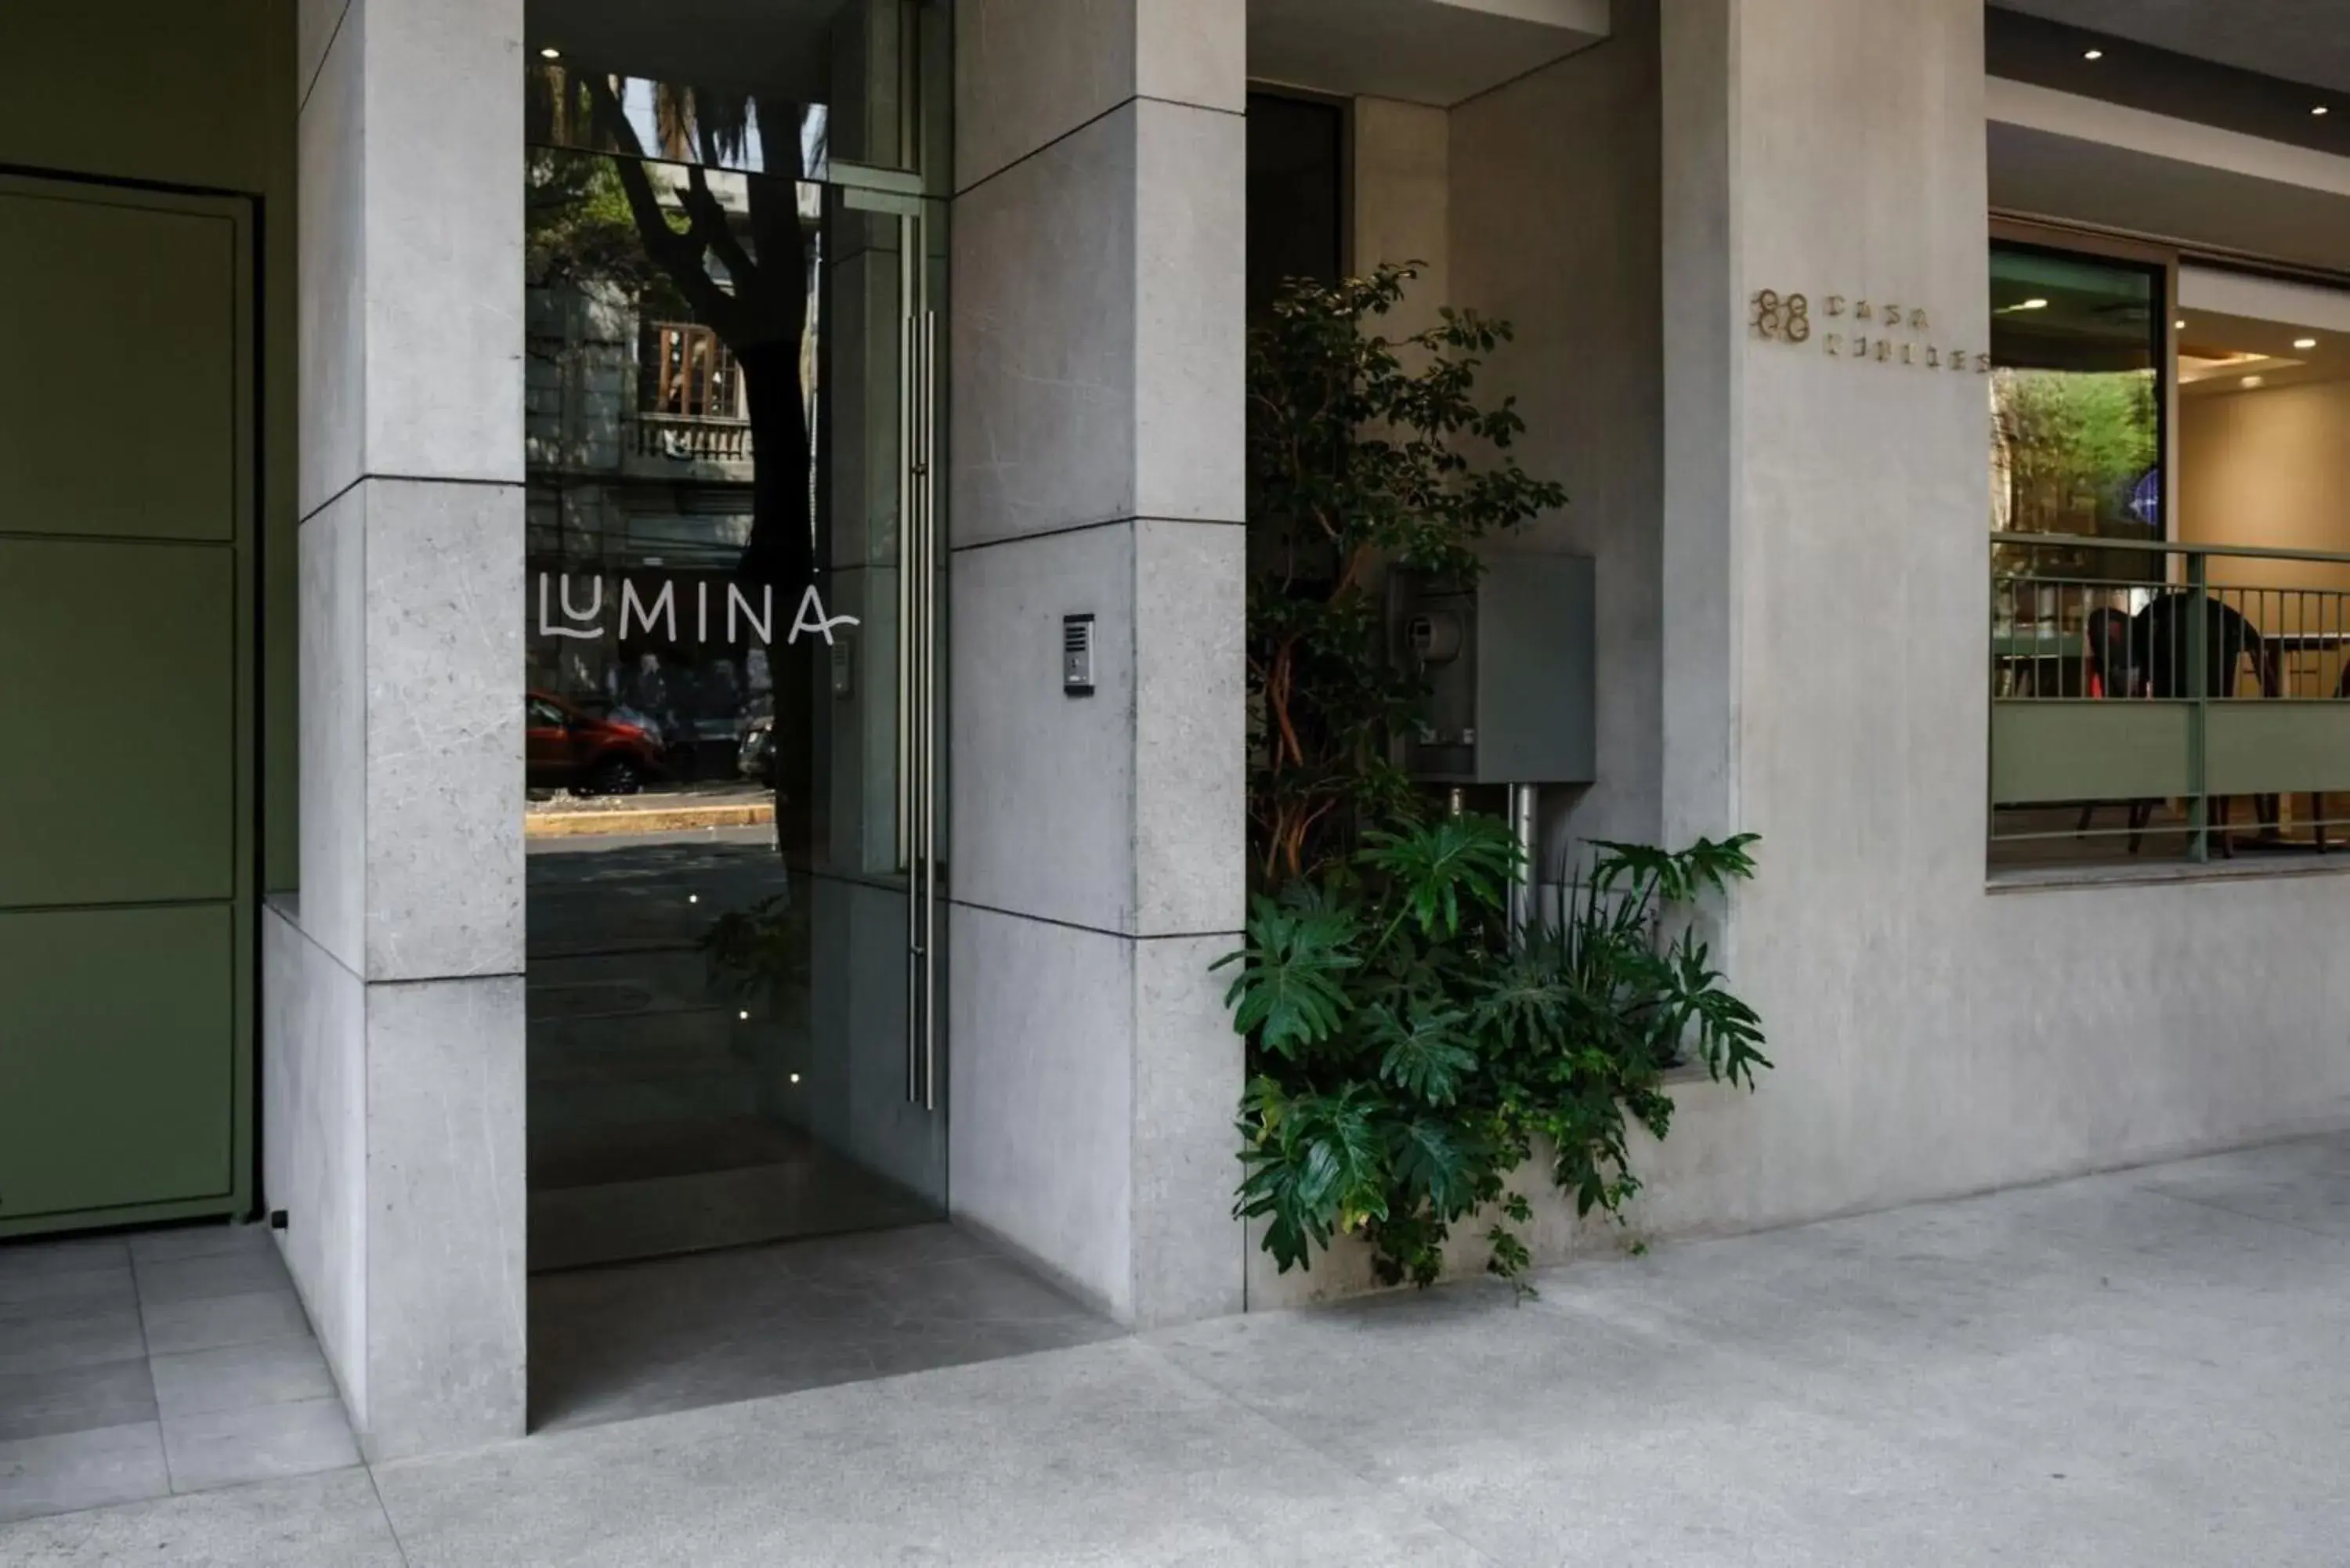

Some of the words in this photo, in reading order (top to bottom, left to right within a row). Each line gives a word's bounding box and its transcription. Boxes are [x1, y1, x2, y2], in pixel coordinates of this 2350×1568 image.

[1755, 288, 1810, 342] 88
[1824, 294, 1929, 329] CASA
[539, 572, 861, 646] LUMINA
